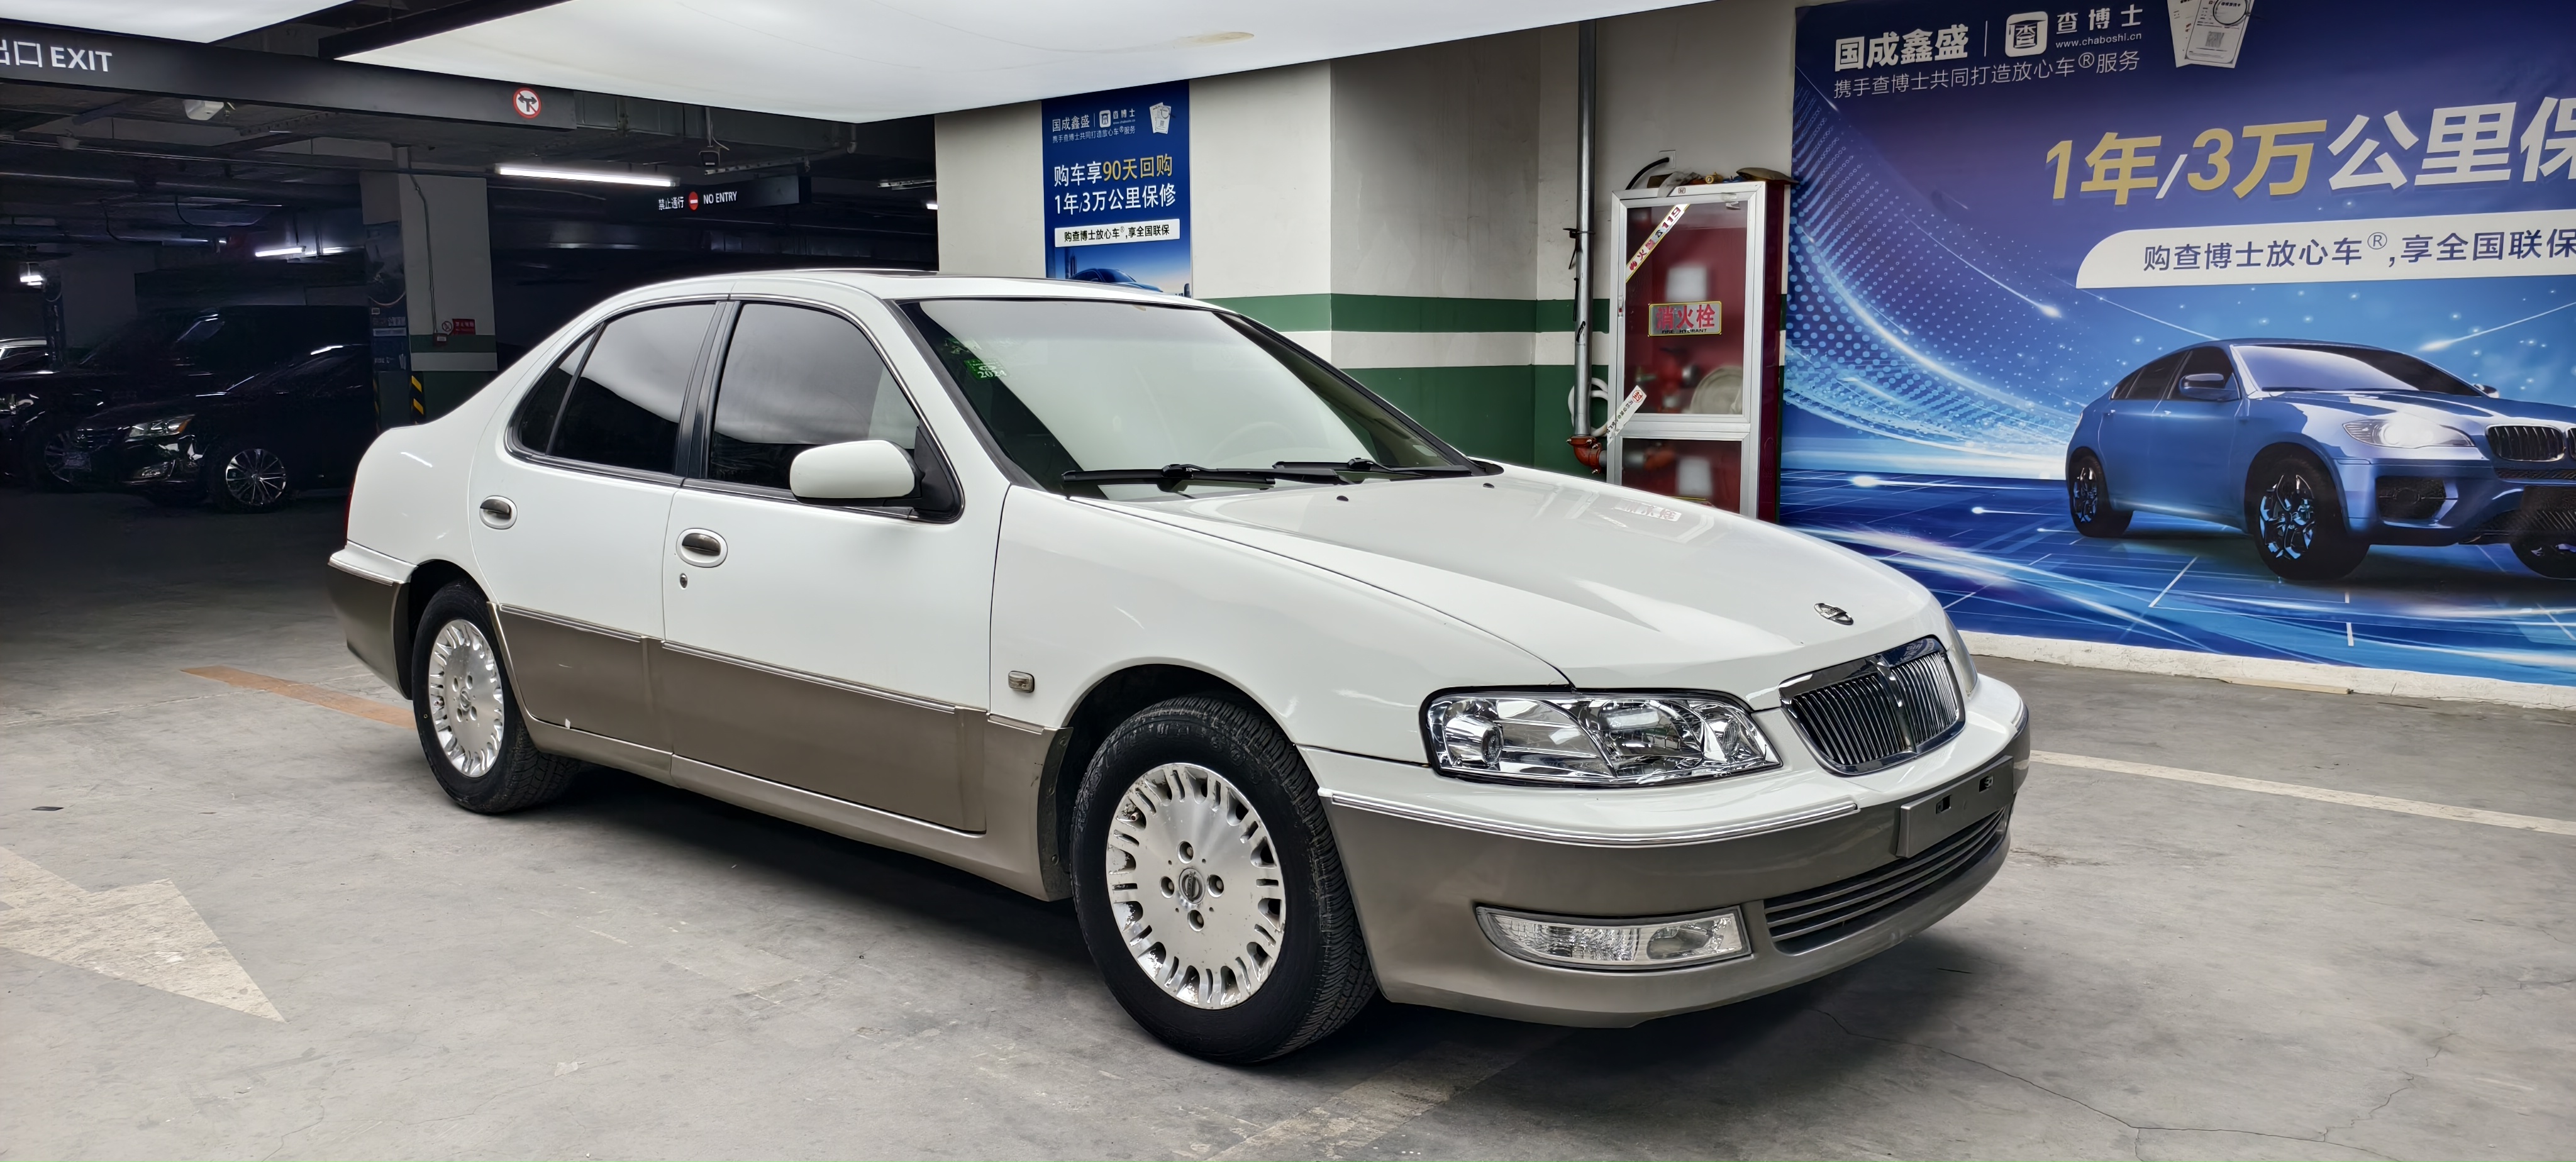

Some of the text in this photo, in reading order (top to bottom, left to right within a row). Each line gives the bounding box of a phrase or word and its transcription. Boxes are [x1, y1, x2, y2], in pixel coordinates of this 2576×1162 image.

[2056, 4, 2143, 35] 查博士
[1835, 23, 1969, 72] 国成鑫盛
[2055, 32, 2142, 49] www.chaboshi.cn
[50, 46, 113, 72] EXIT
[1052, 114, 1090, 133] 国成鑫盛
[1054, 153, 1172, 187] 购车享90天回购
[658, 191, 737, 211] 禁止通行 NO ENTRY
[1055, 182, 1176, 215] 1年/3万公里保修
[1662, 206, 1681, 229] 119
[1656, 304, 1716, 329] 消火栓
[977, 370, 1006, 378] 2024
